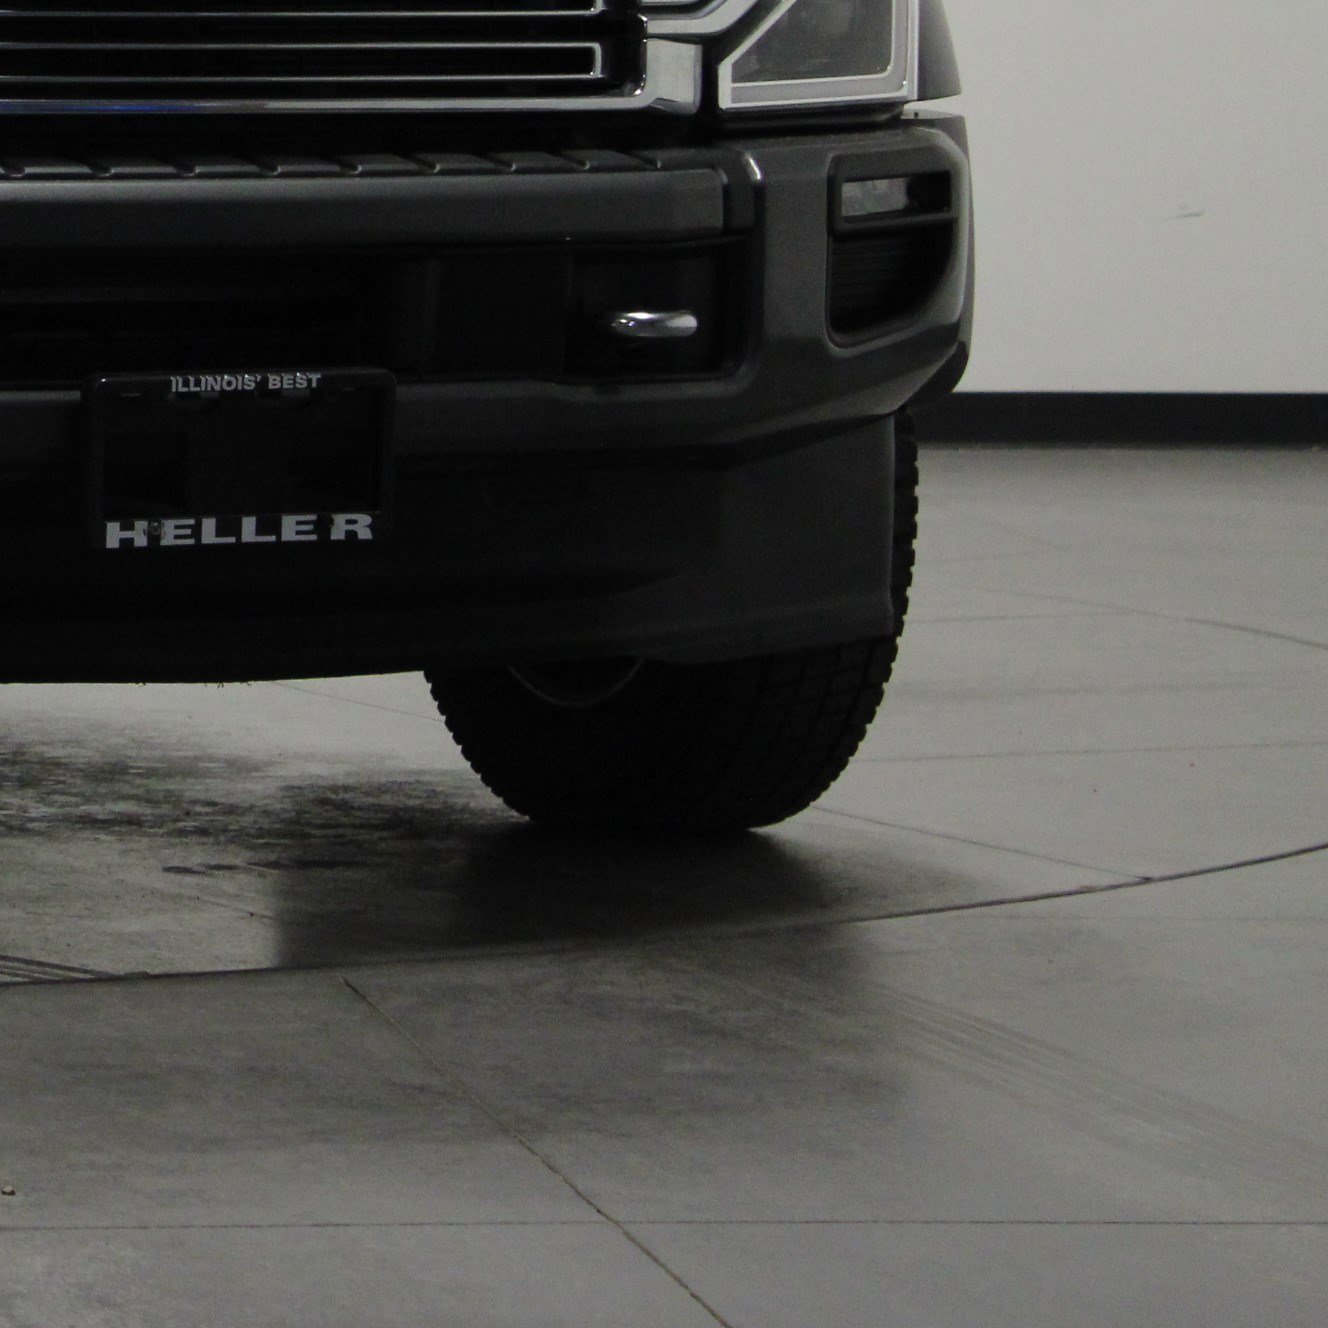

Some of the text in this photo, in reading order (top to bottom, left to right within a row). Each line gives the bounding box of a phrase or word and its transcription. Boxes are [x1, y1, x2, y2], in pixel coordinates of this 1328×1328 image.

[171, 372, 322, 393] ILLINOIS' BEST
[106, 514, 373, 548] HELLER
